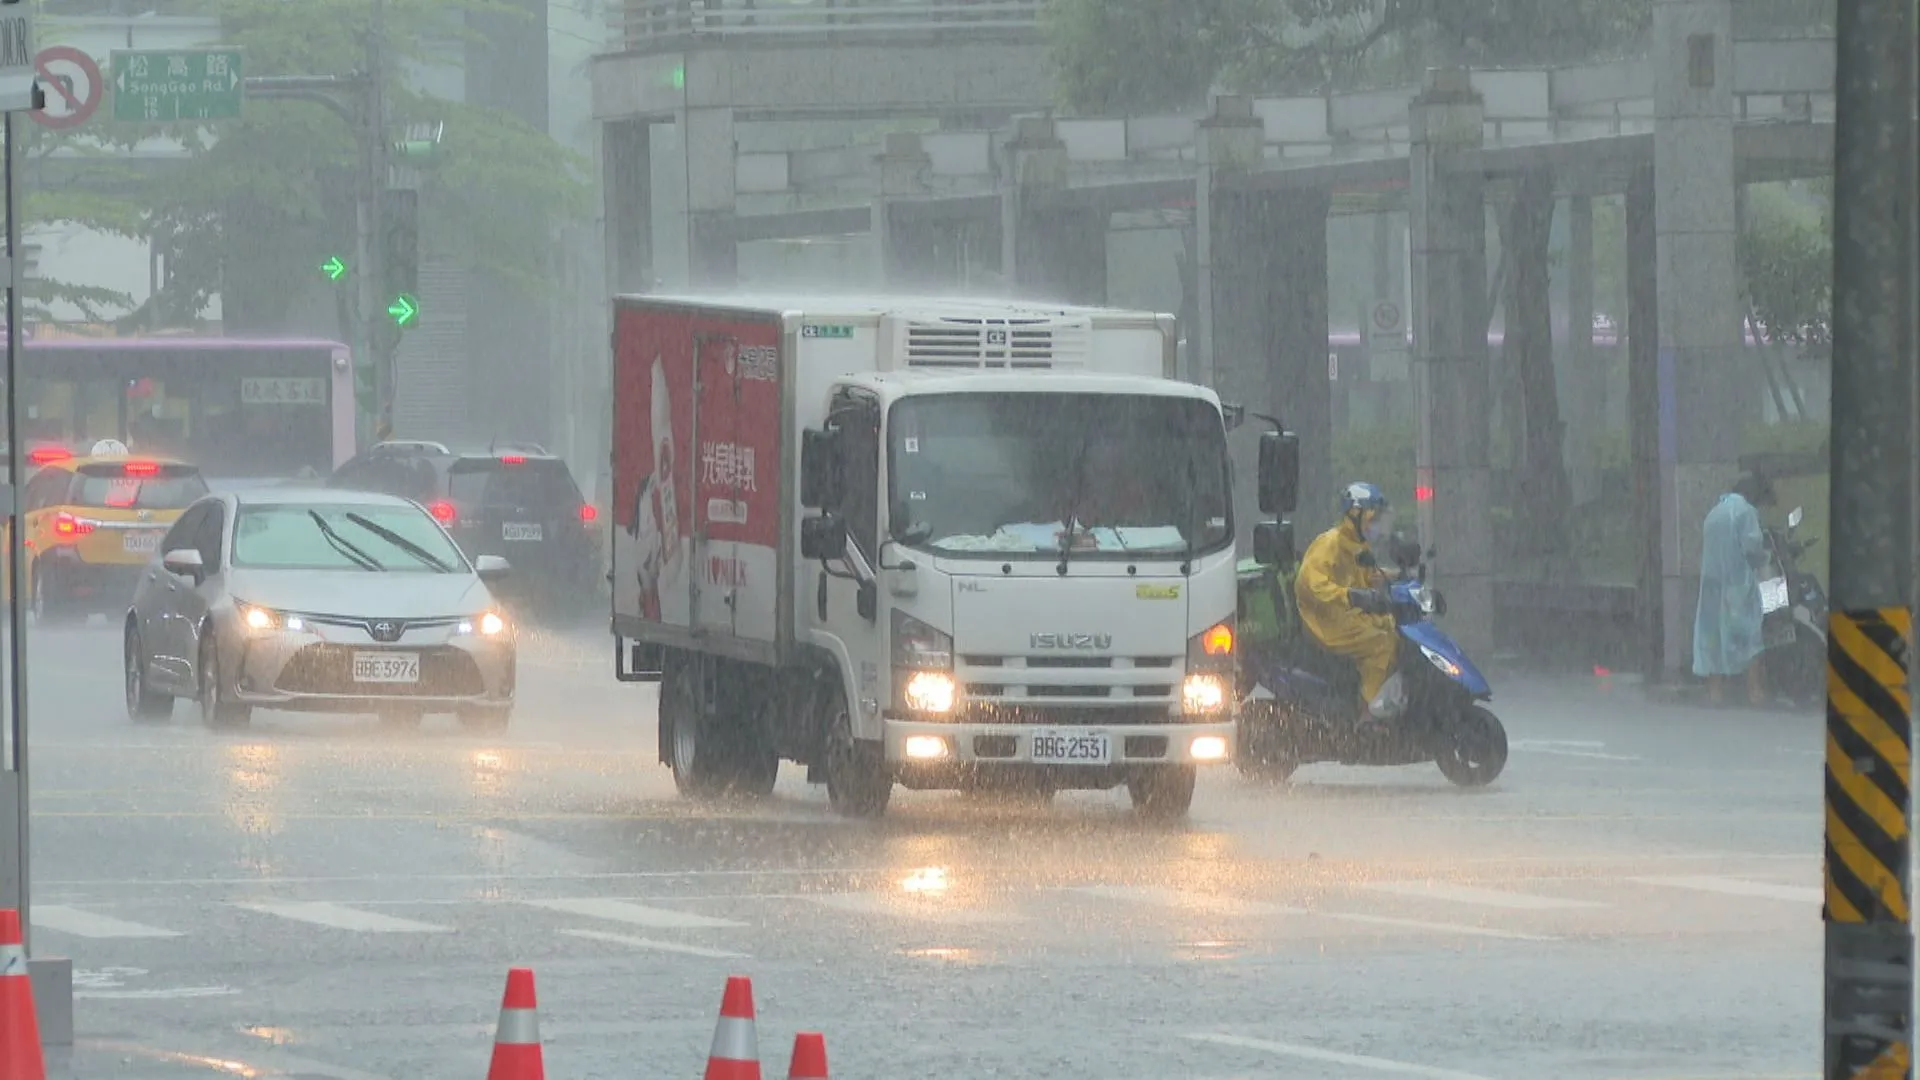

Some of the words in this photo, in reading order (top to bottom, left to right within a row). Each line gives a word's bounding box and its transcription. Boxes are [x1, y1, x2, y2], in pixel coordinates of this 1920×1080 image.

[129, 55, 229, 77] 松高路
[1030, 632, 1112, 649] ISUZU
